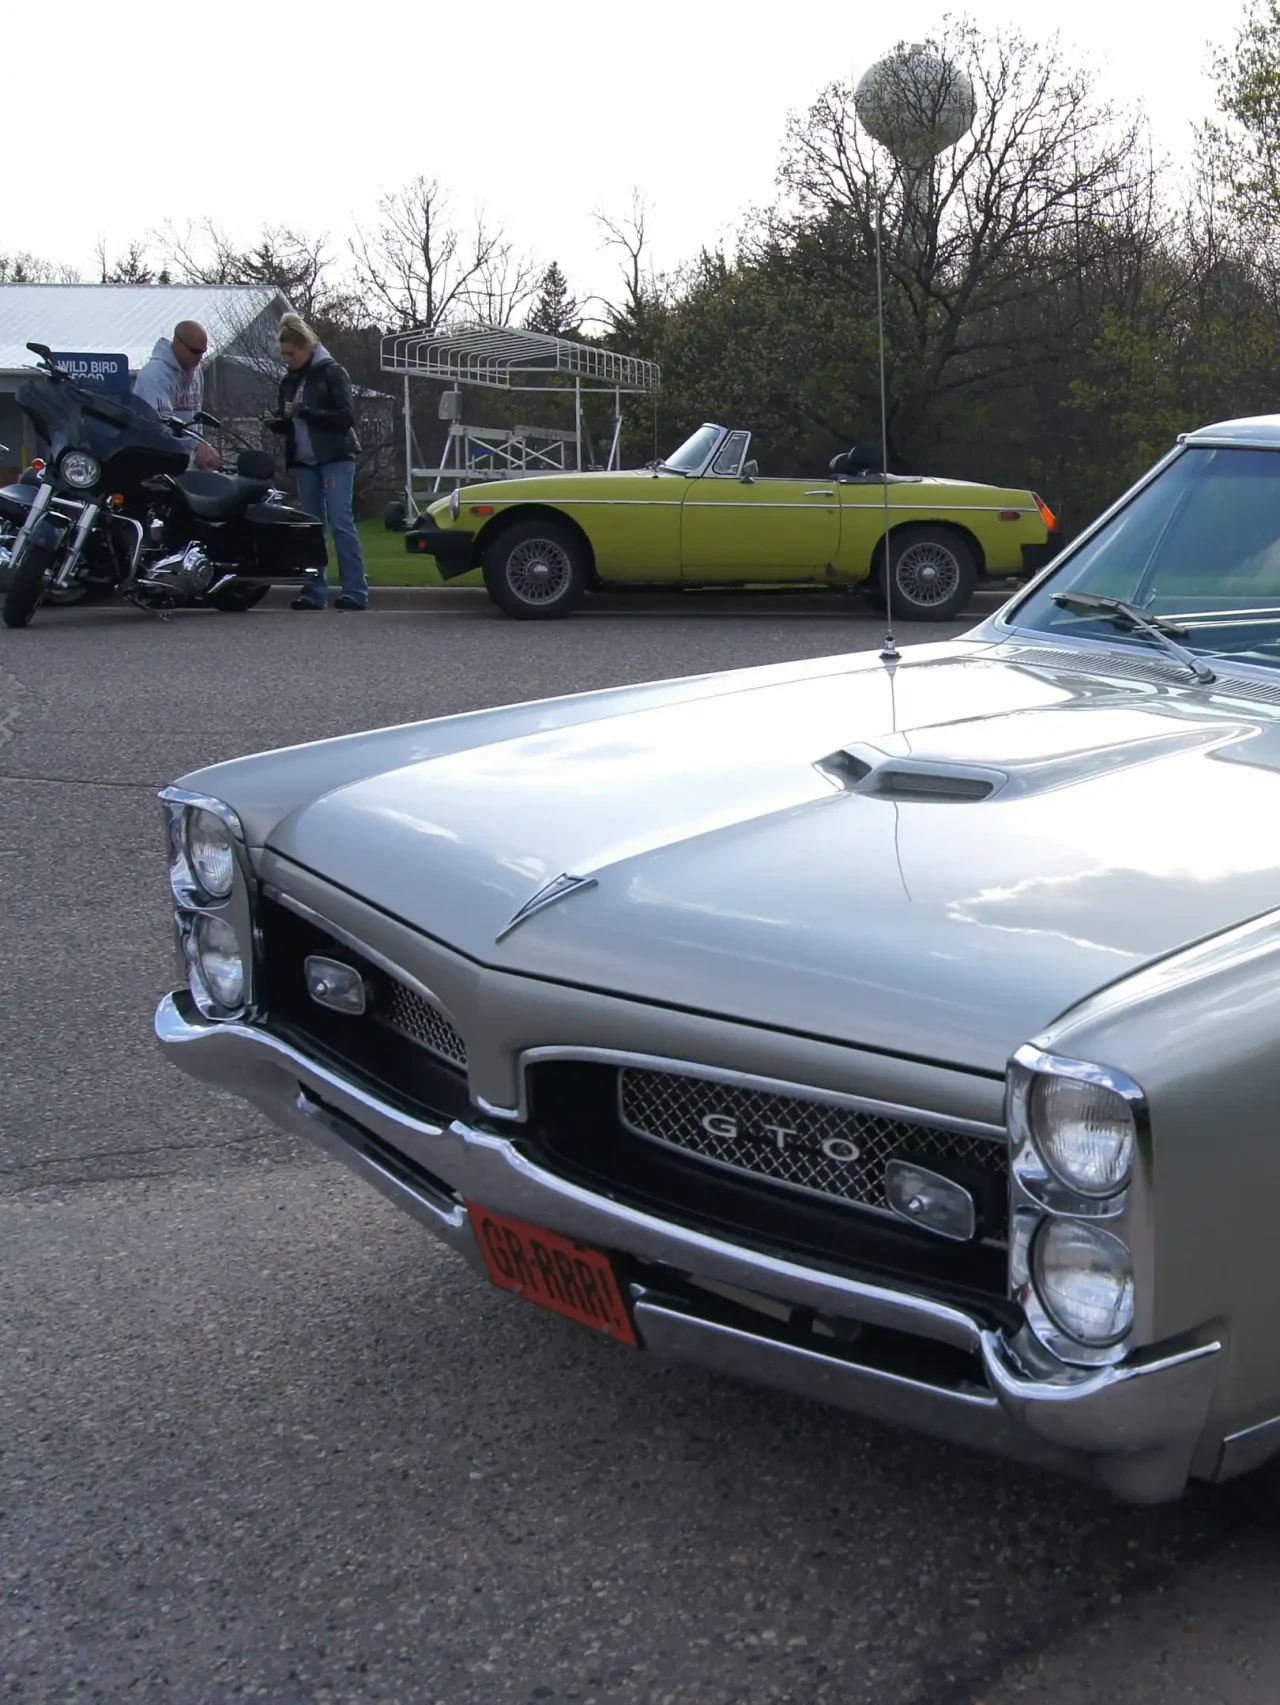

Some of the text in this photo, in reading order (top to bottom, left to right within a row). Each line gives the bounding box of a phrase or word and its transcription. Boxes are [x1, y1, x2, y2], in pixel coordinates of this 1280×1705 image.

[57, 360, 118, 374] WILD BIRD
[702, 1113, 860, 1161] GTO
